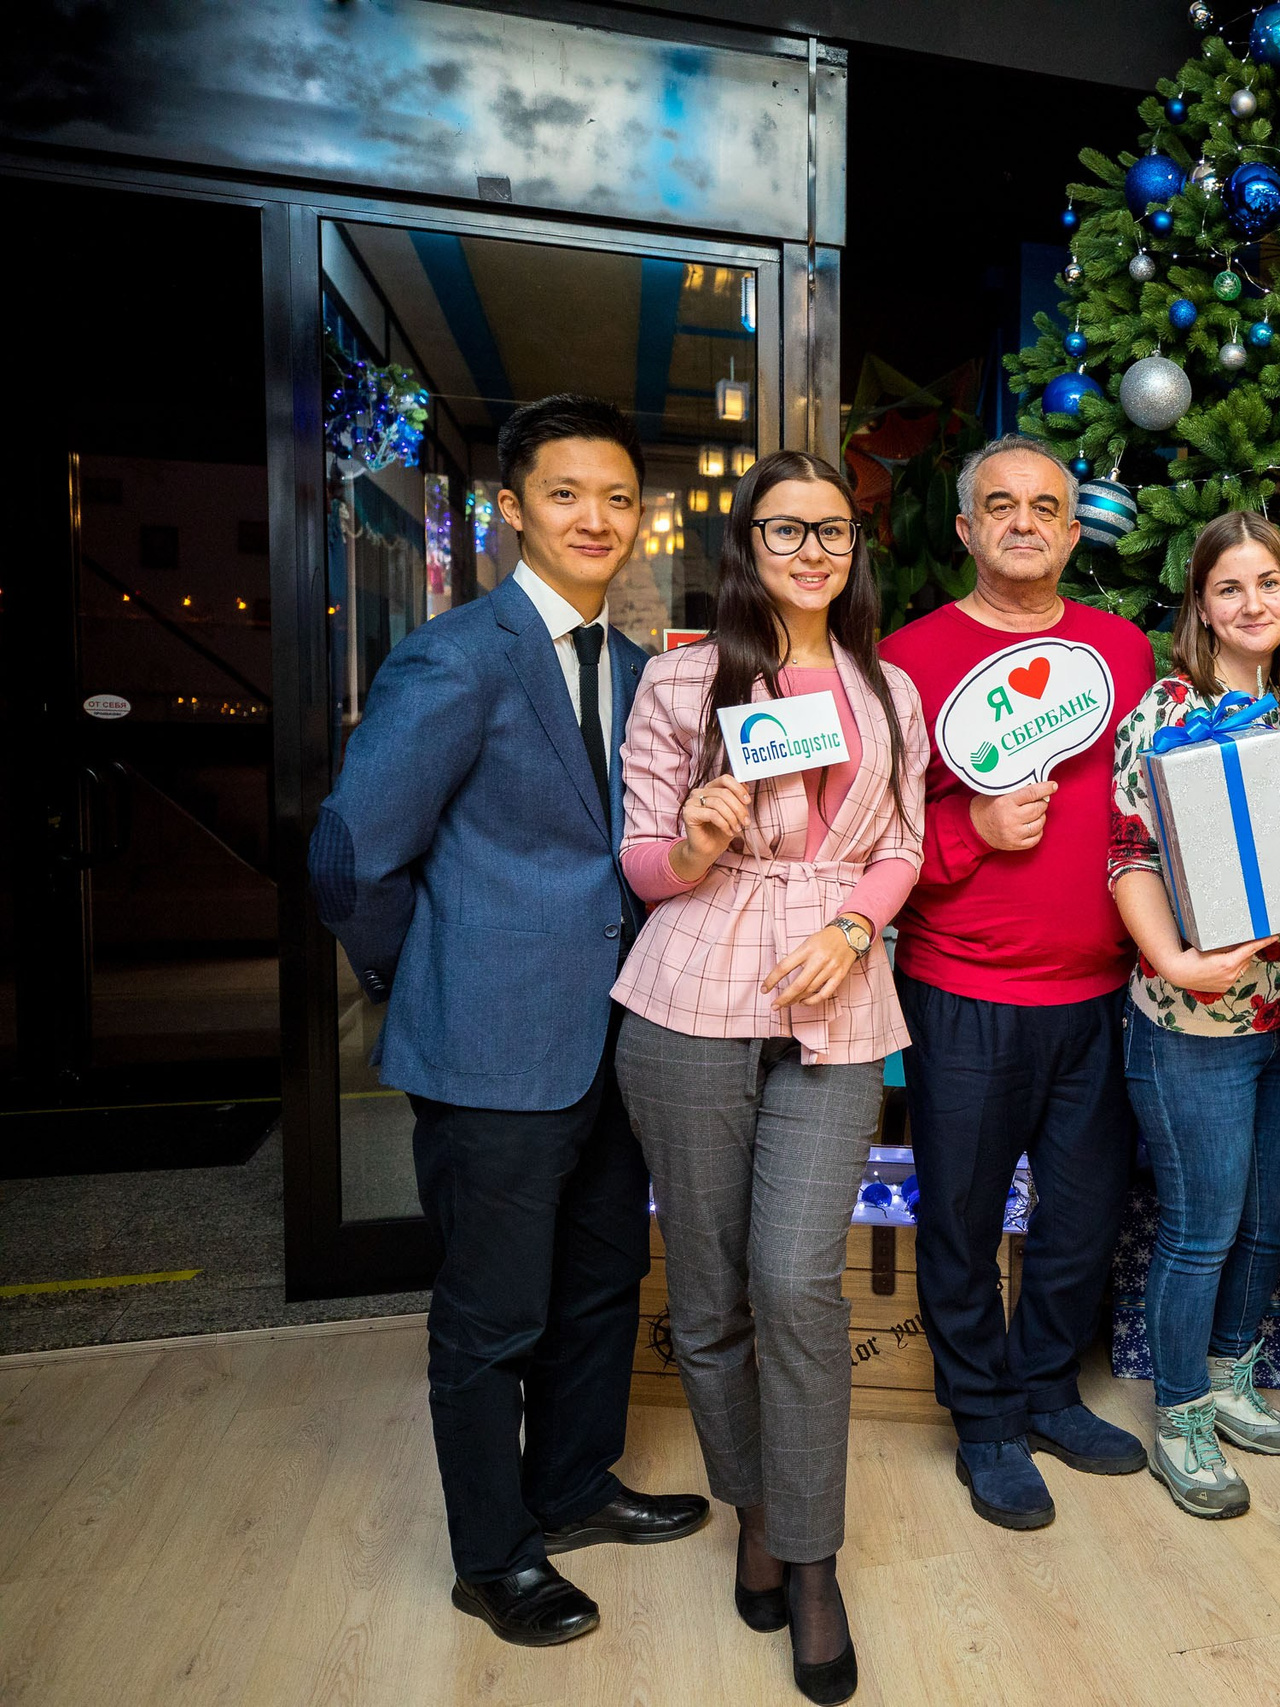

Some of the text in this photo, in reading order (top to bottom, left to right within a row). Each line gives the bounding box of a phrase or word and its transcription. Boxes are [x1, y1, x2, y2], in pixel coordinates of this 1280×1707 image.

[102, 701, 127, 709] СЕБЯ
[987, 686, 1014, 722] Я
[1001, 689, 1098, 751] СБЕРБАНК
[851, 1336, 881, 1366] or
